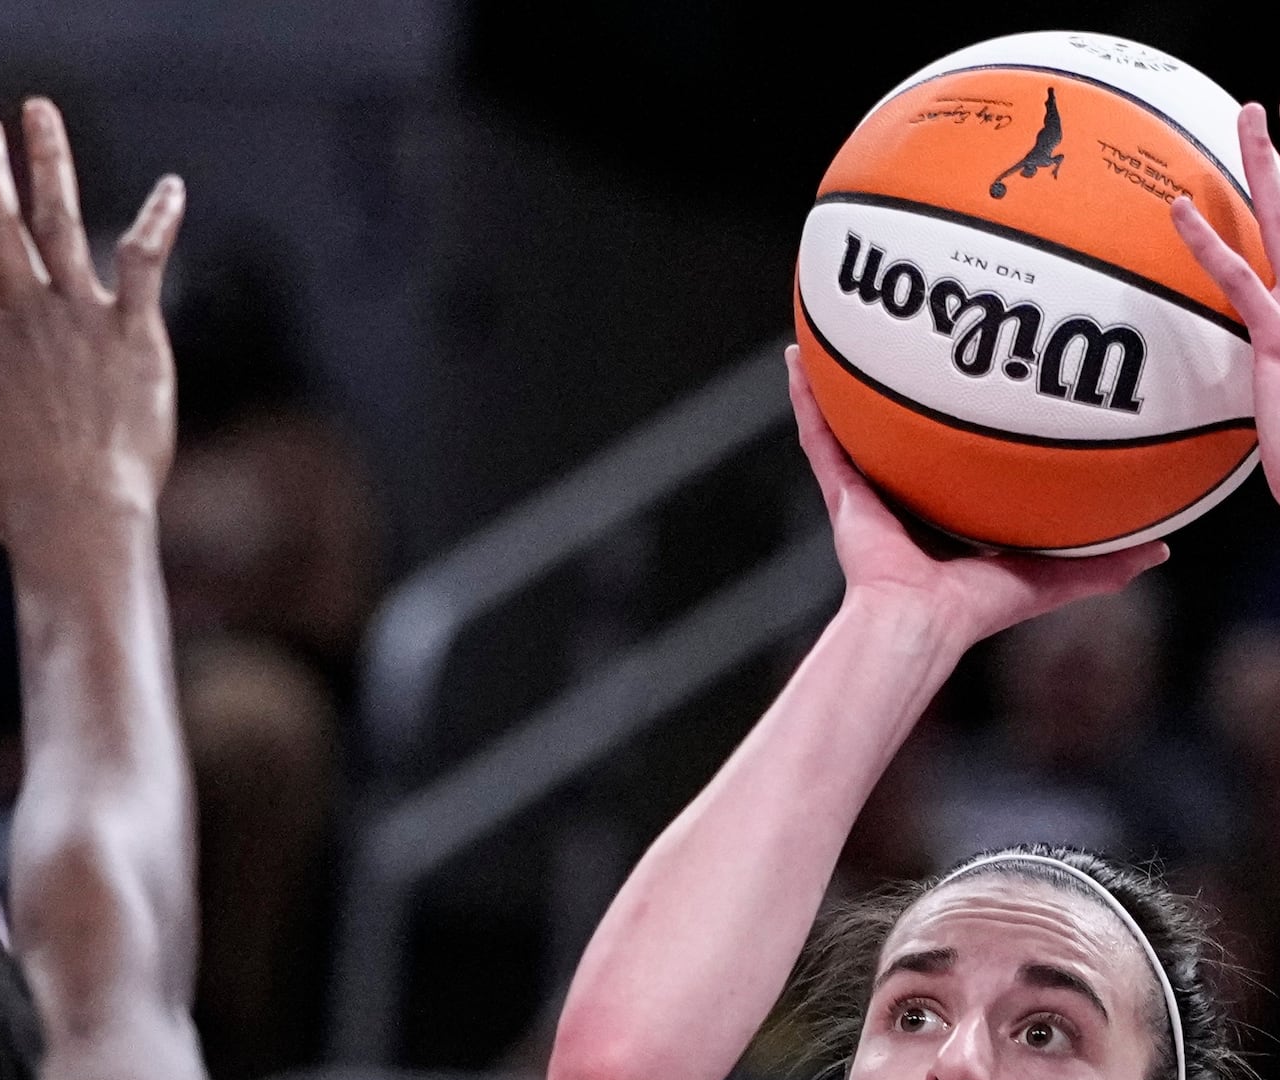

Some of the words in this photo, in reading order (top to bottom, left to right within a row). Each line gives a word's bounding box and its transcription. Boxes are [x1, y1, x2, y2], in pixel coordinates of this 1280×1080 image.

[1097, 140, 1142, 171] BALL
[1103, 158, 1176, 206] OFFICIAL
[950, 250, 989, 271] NXT
[996, 265, 1036, 285] EVO
[838, 231, 1147, 415] Wilson
